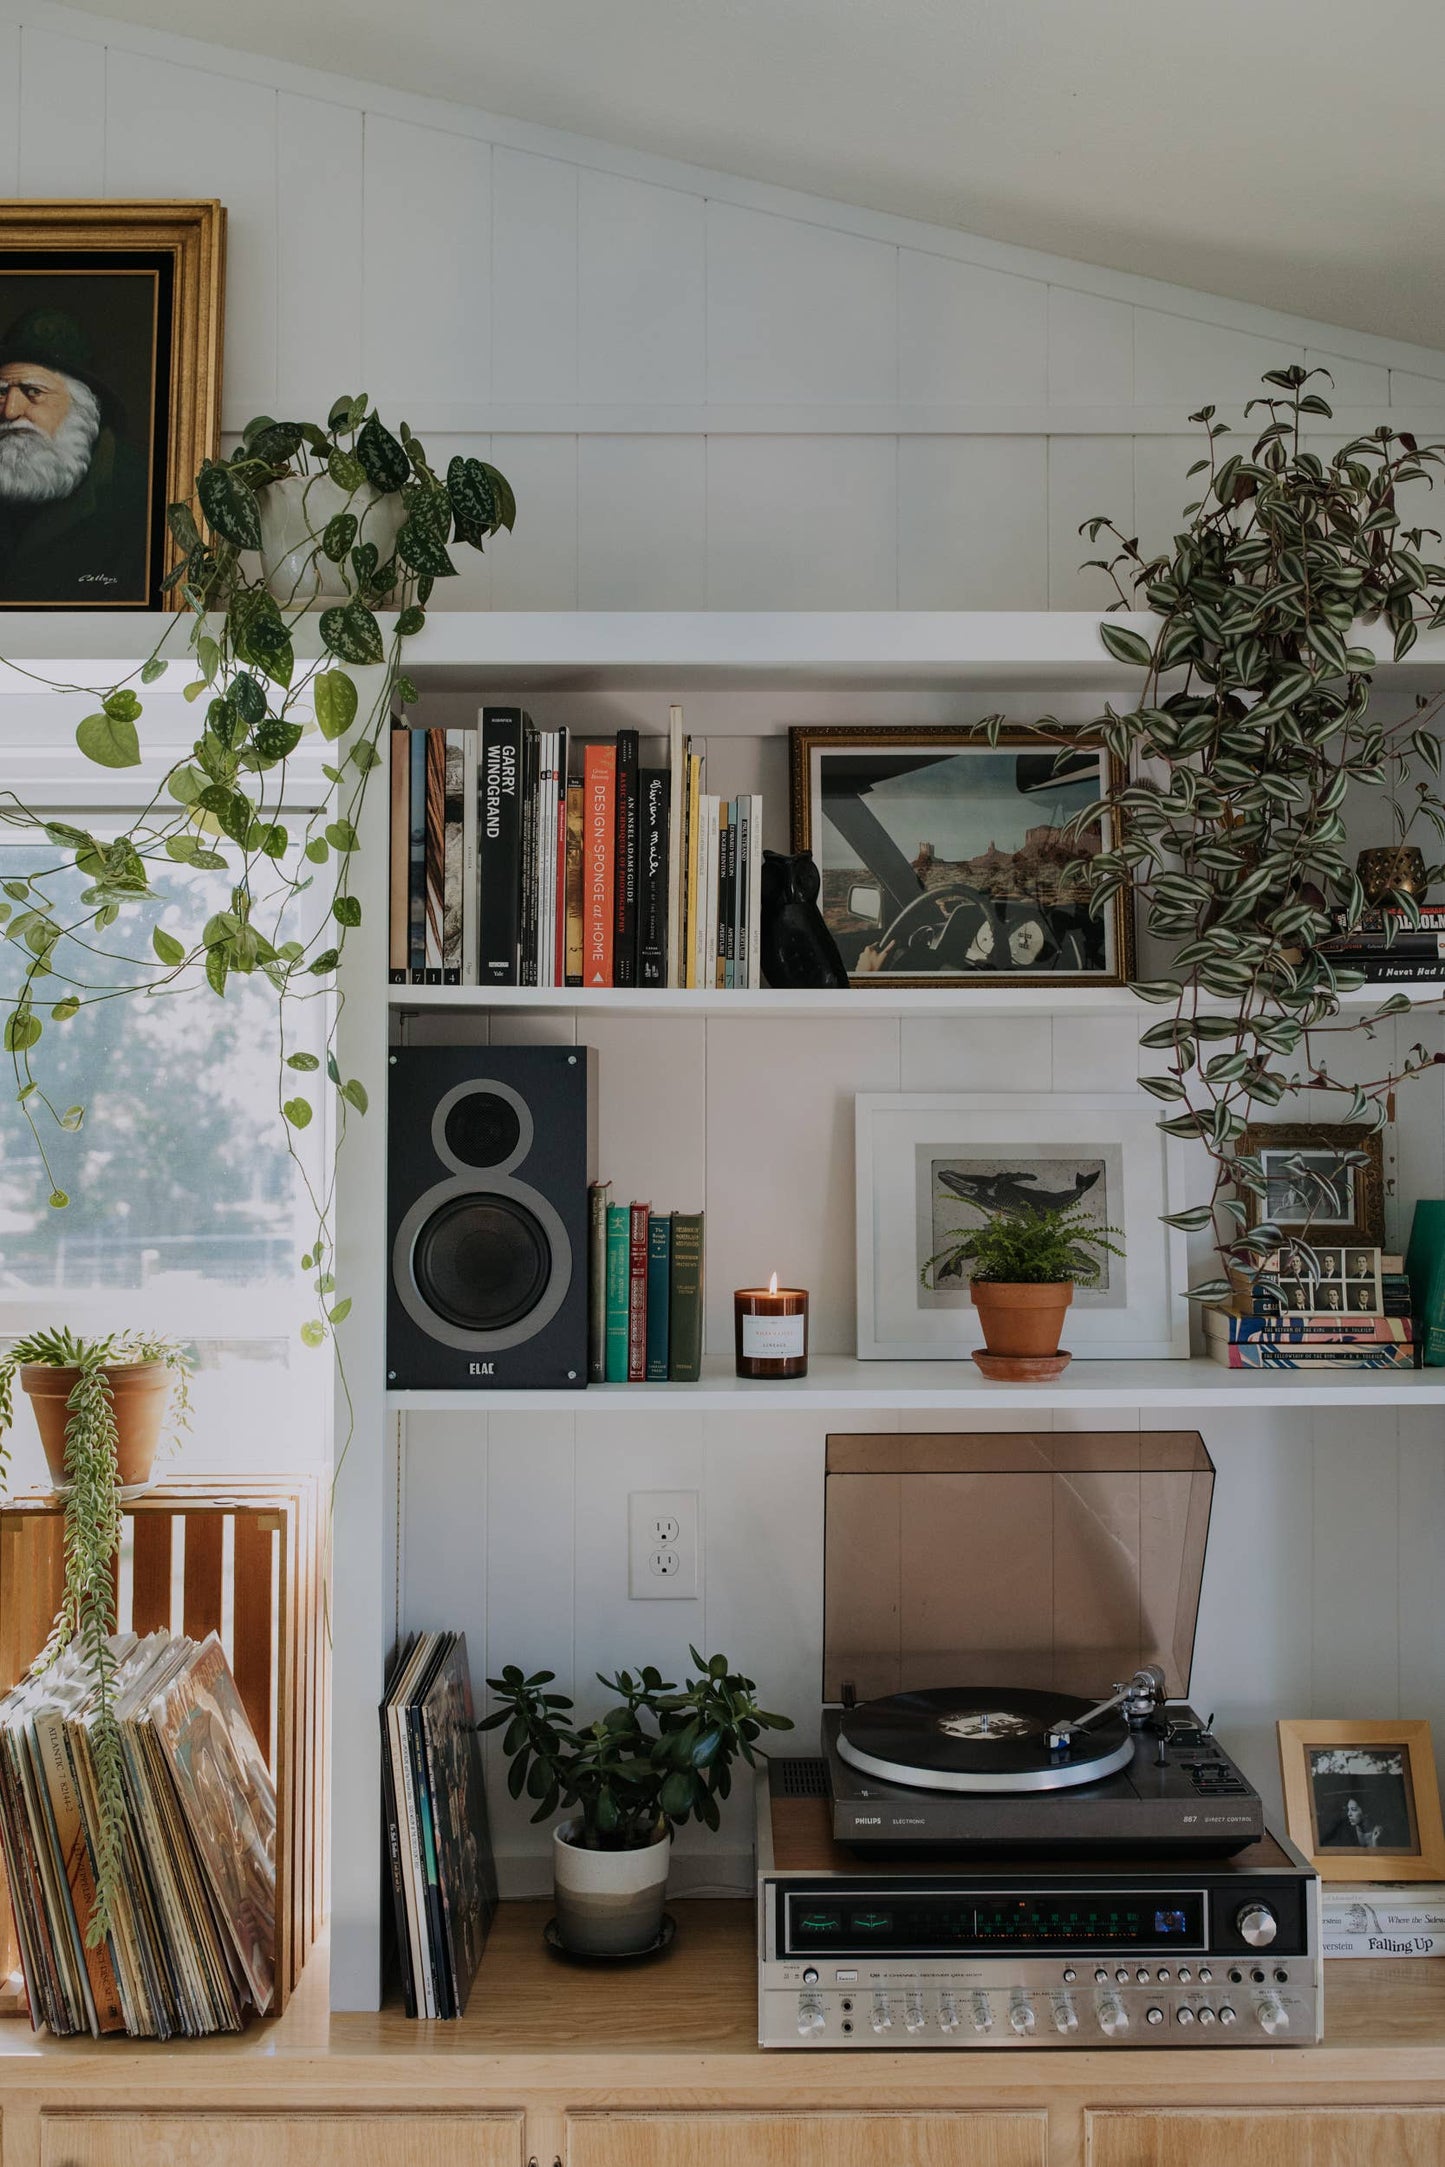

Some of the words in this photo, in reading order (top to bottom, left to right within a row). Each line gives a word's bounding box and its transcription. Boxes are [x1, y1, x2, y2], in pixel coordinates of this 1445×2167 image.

[502, 745, 516, 796] GARRY
[486, 745, 501, 839] WINOGRAND
[627, 796, 635, 809] AN
[649, 779, 662, 826] Vivian
[619, 857, 625, 867] OF
[593, 904, 604, 919] at
[593, 922, 604, 961] HOME
[414, 973, 422, 982] 7
[1378, 967, 1383, 976] I
[1386, 966, 1414, 976] Never
[1417, 966, 1438, 976] Had
[394, 973, 403, 983] 6
[448, 974, 455, 983] 4
[469, 1362, 495, 1375] ELAC
[48, 1727, 65, 1771] ATLANTIC
[60, 1782, 74, 1813] 82144-2
[855, 1817, 882, 1825] PHILIPS
[79, 1863, 92, 1905] ZEPPELIN
[1388, 1915, 1411, 1924] Where
[1412, 1915, 1423, 1924] the
[1368, 1937, 1414, 1955] Falling
[1413, 1937, 1435, 1953] Up
